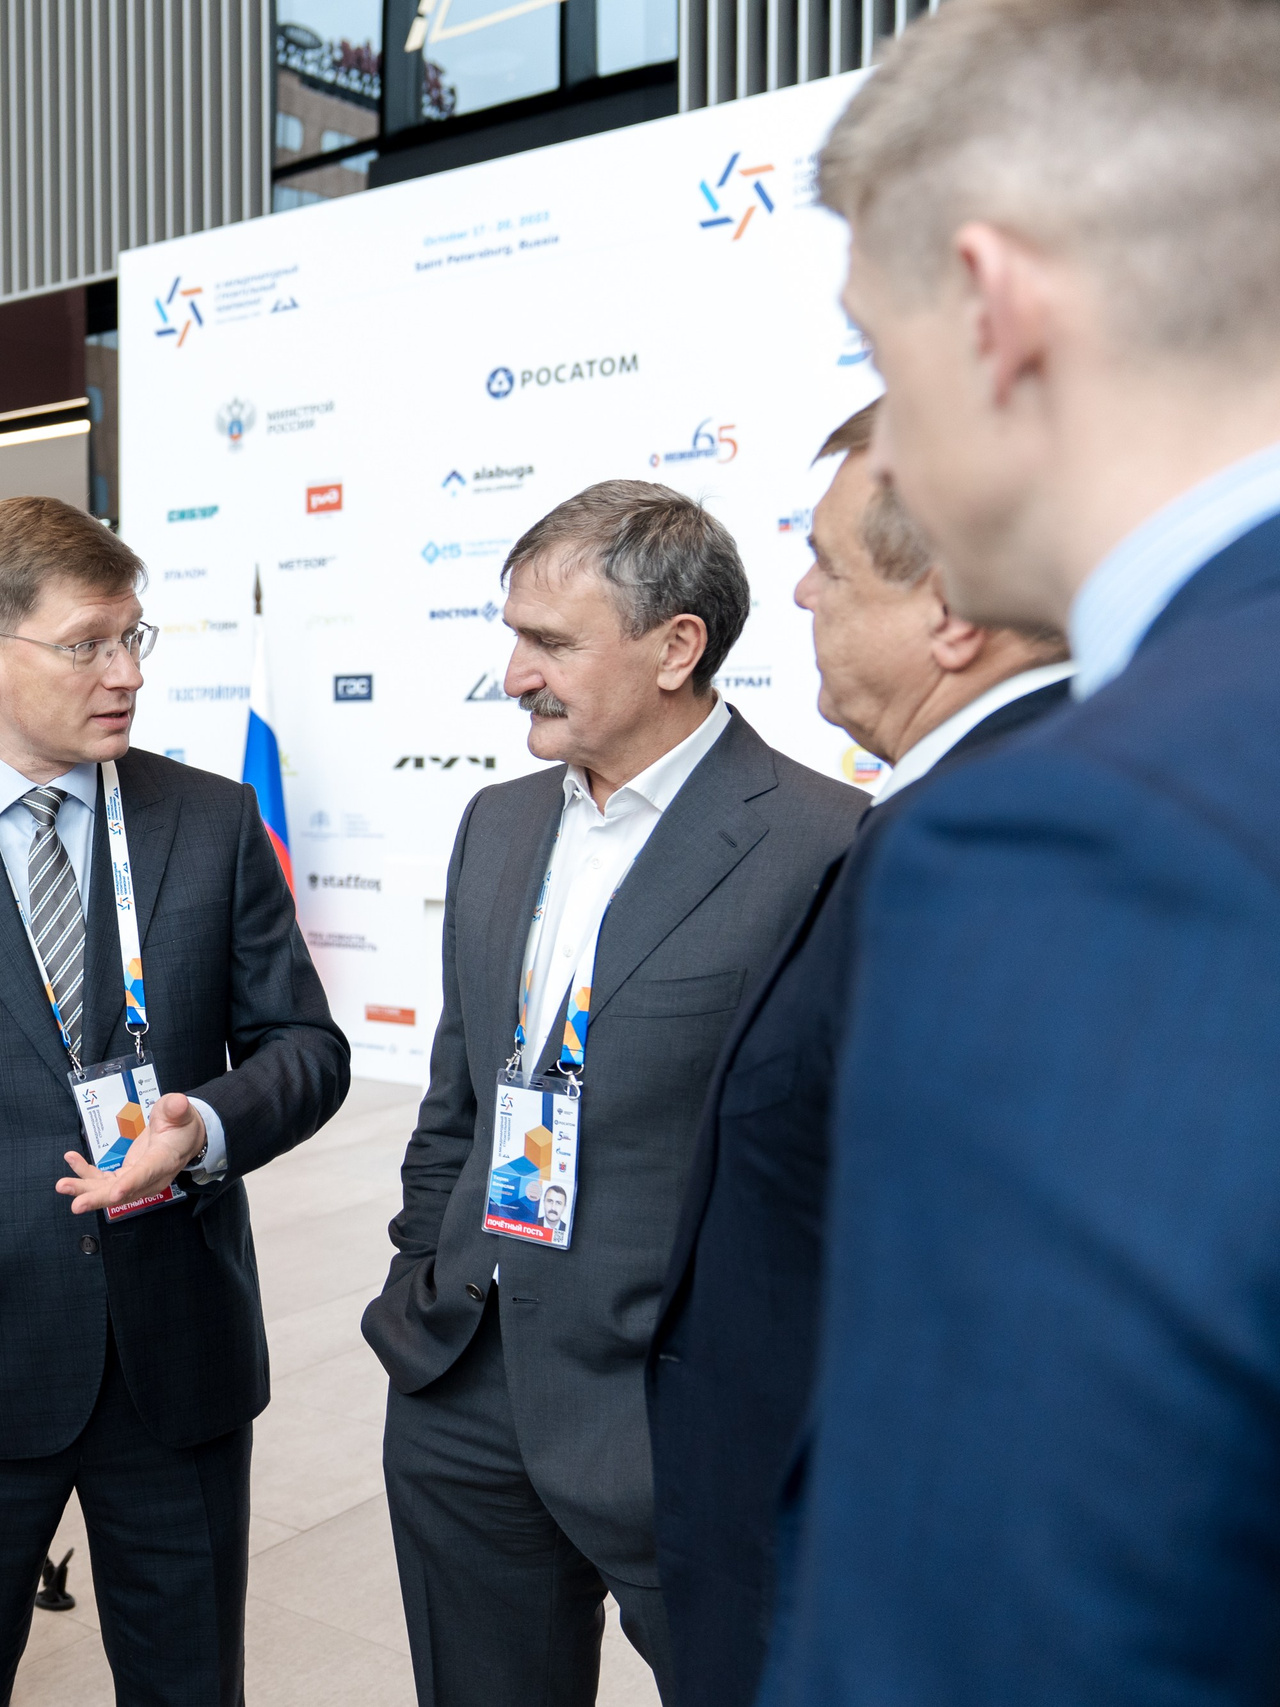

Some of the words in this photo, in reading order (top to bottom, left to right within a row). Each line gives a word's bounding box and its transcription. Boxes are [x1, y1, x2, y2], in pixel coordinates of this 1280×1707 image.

[521, 353, 639, 388] РОСАТОМ
[473, 464, 535, 483] alabuga
[144, 1192, 165, 1204] ГОСТЬ
[523, 1225, 544, 1238] ГОСТЬ
